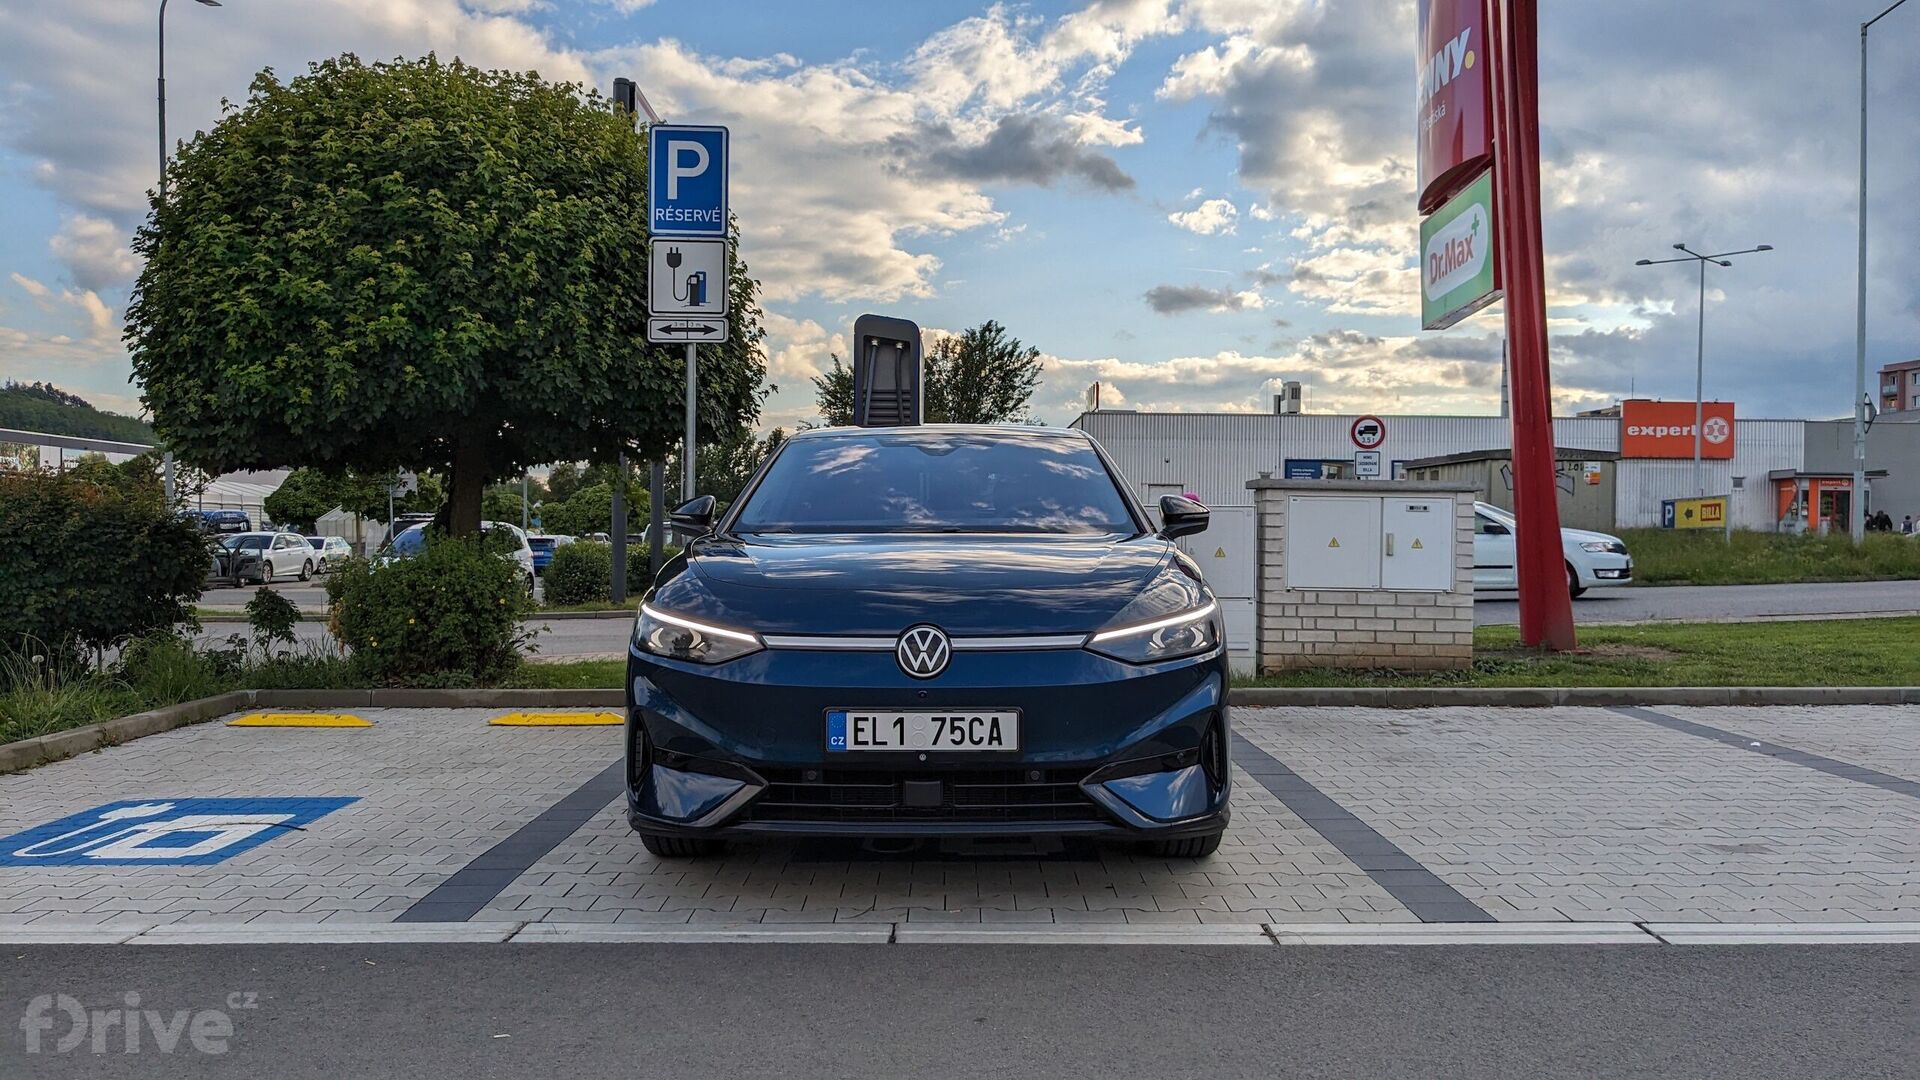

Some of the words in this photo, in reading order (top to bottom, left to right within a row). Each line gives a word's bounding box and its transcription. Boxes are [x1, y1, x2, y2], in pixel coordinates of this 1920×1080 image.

[667, 140, 710, 200] P
[655, 206, 721, 223] RÉSERVÉ
[1430, 234, 1474, 285] Dr.Max
[1664, 505, 1673, 526] P
[1702, 506, 1720, 519] BILLA
[830, 736, 845, 746] CZ
[853, 716, 905, 746] EL1
[931, 716, 1003, 746] 75CA
